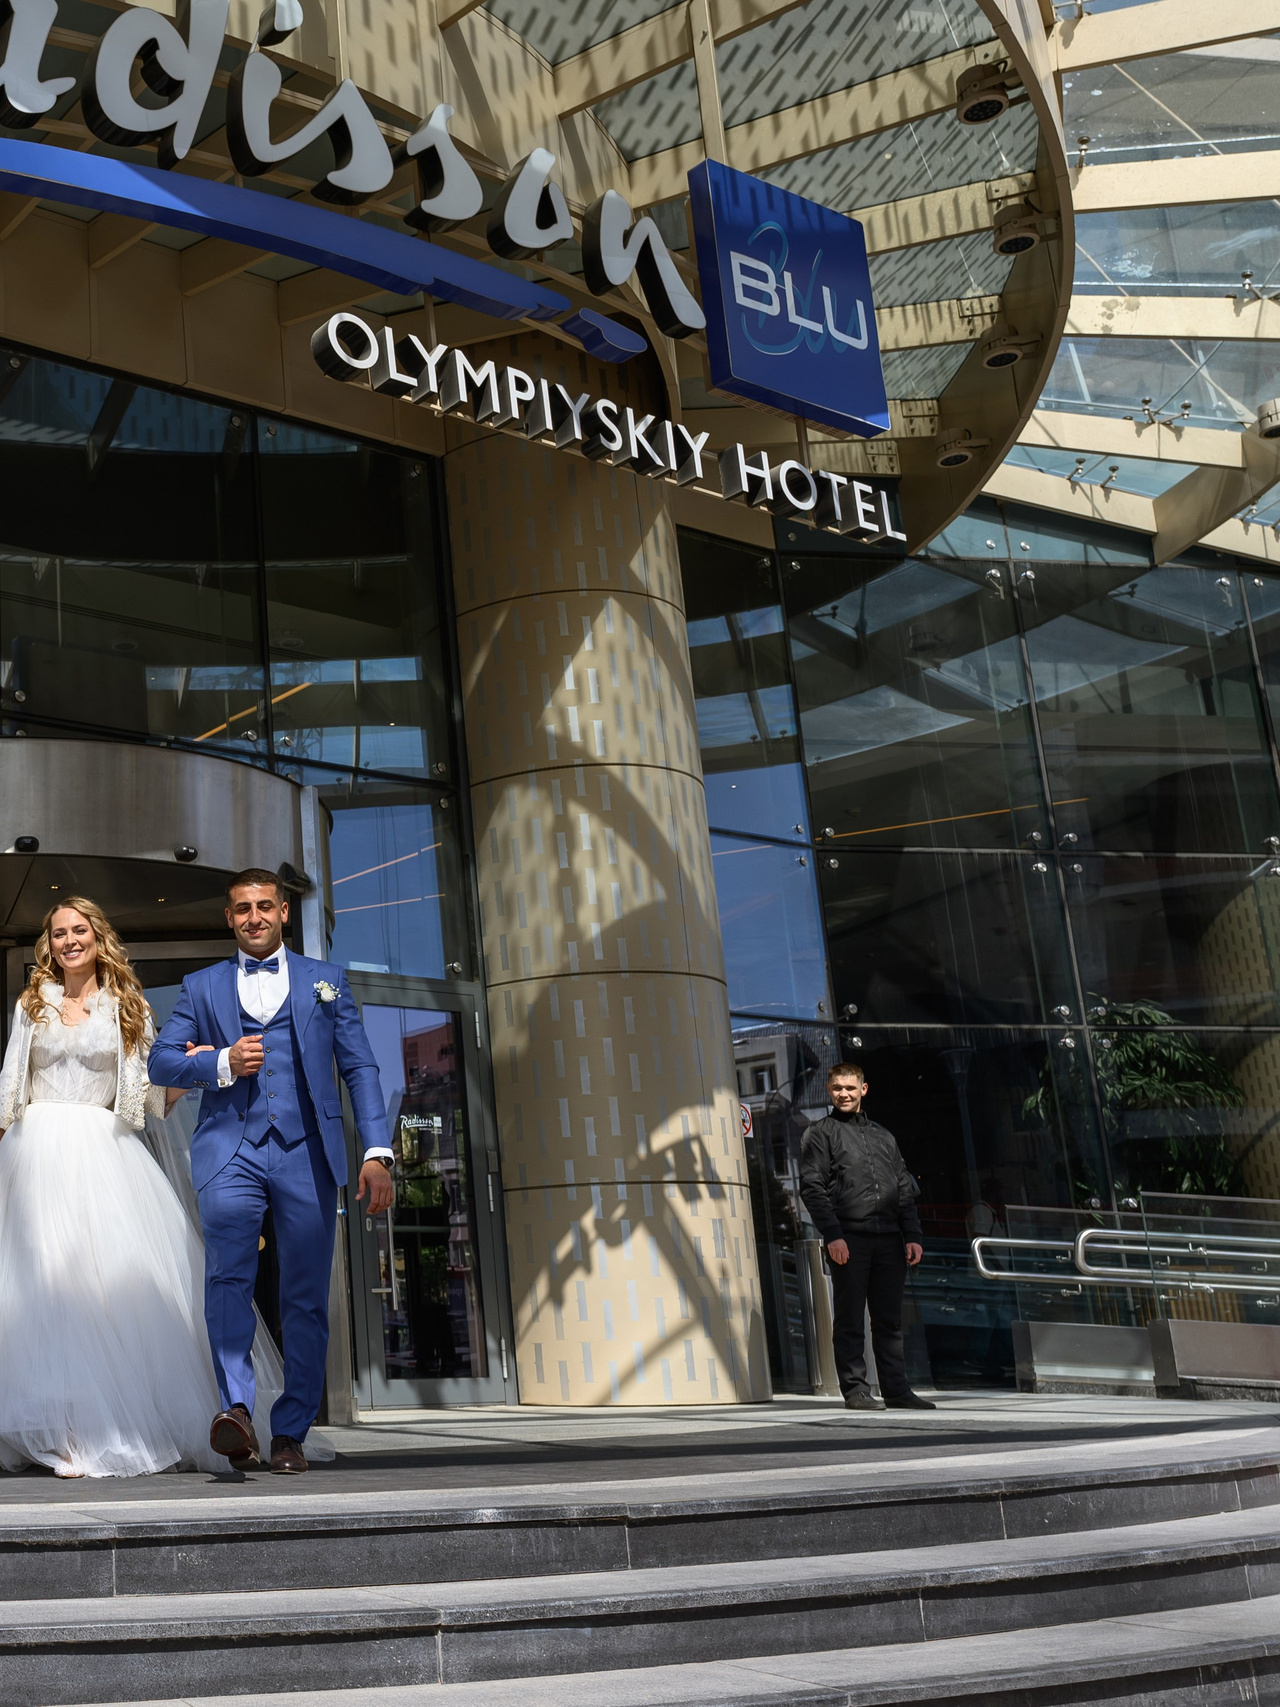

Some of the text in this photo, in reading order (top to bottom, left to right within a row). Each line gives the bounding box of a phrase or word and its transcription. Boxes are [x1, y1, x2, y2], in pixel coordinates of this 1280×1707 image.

[730, 250, 869, 351] BLU
[321, 311, 907, 542] OLYMPIYSKIY HOTEL
